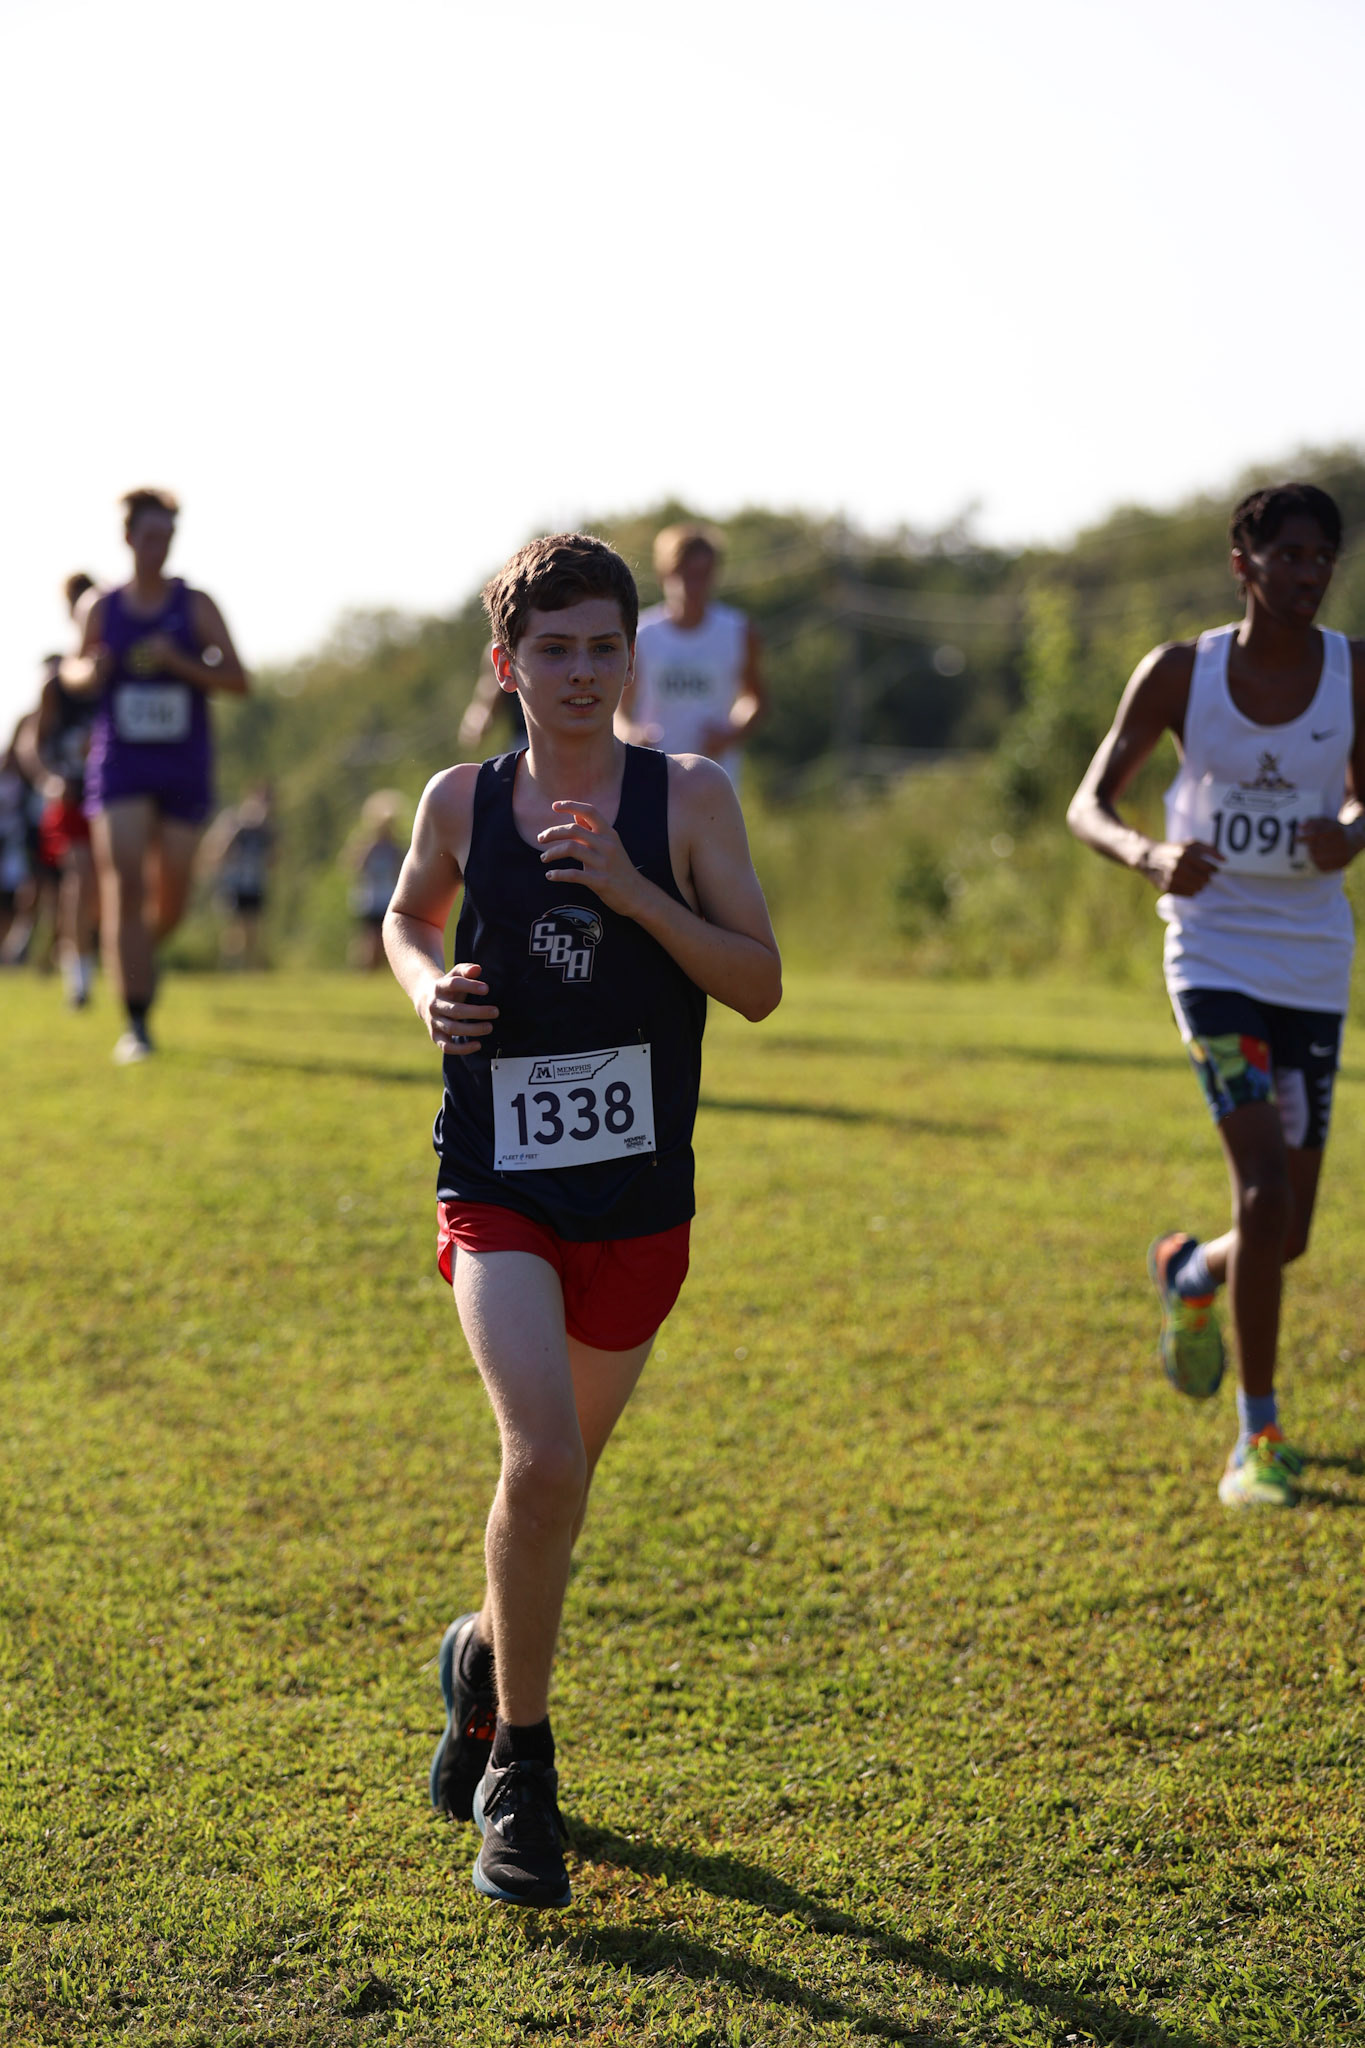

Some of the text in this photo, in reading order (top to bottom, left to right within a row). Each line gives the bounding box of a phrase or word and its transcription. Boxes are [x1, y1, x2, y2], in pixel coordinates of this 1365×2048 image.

[1212, 810, 1299, 857] 1091
[532, 922, 591, 978] SBA
[536, 1066, 552, 1079] M
[556, 1063, 592, 1073] MEMPHIS
[510, 1081, 635, 1146] 1338
[624, 1134, 646, 1145] MEMPHIS
